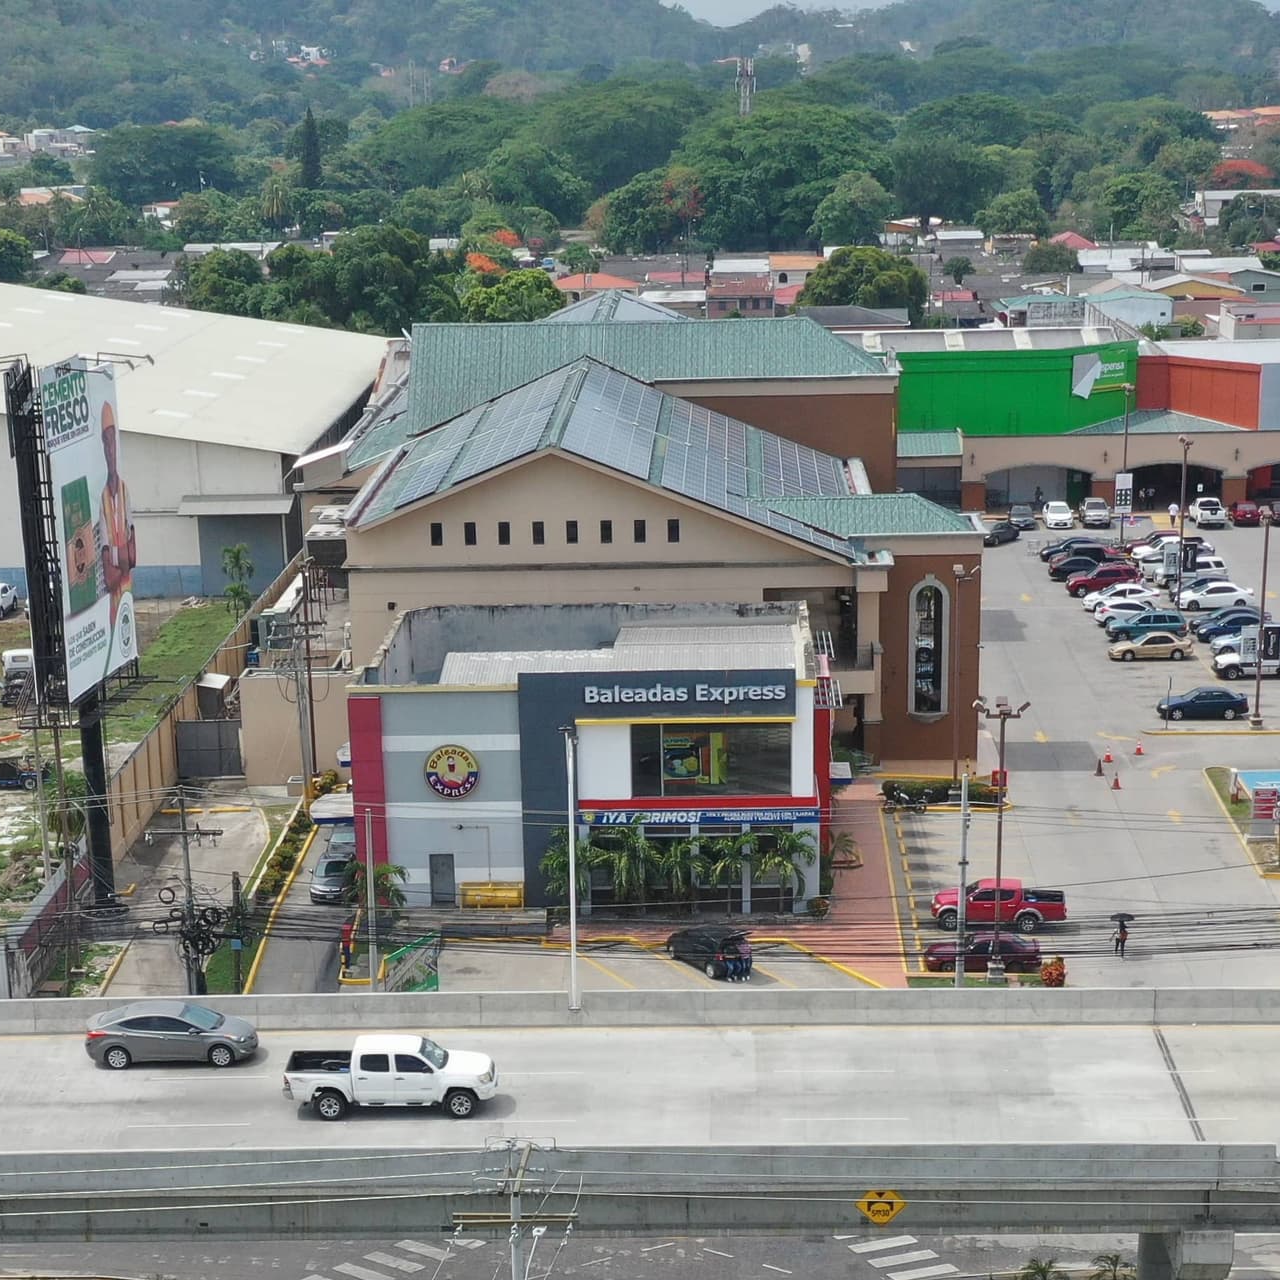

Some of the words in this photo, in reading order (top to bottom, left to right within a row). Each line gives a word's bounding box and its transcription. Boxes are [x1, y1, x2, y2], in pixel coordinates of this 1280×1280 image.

[42, 371, 86, 408] CEMENTO
[43, 394, 89, 440] FRESCO
[584, 684, 689, 703] Baleadas
[695, 684, 787, 704] Express
[429, 748, 474, 769] Baleadas
[429, 775, 475, 797] EXPRESS
